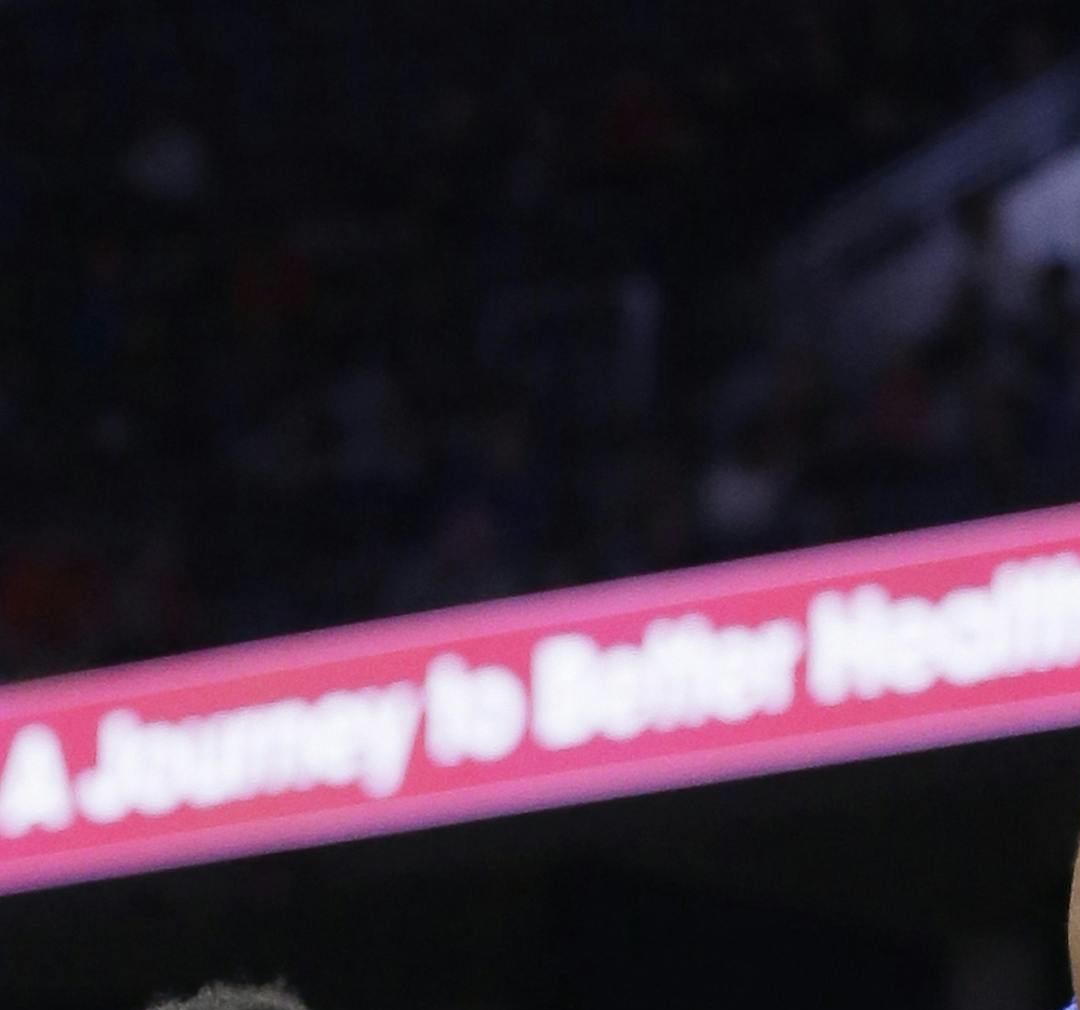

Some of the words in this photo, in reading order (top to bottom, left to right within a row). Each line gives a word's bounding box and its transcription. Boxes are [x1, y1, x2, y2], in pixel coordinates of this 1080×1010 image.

[0, 726, 72, 834] A
[72, 684, 422, 822] Journey
[425, 655, 529, 763] to
[531, 616, 801, 747] Better
